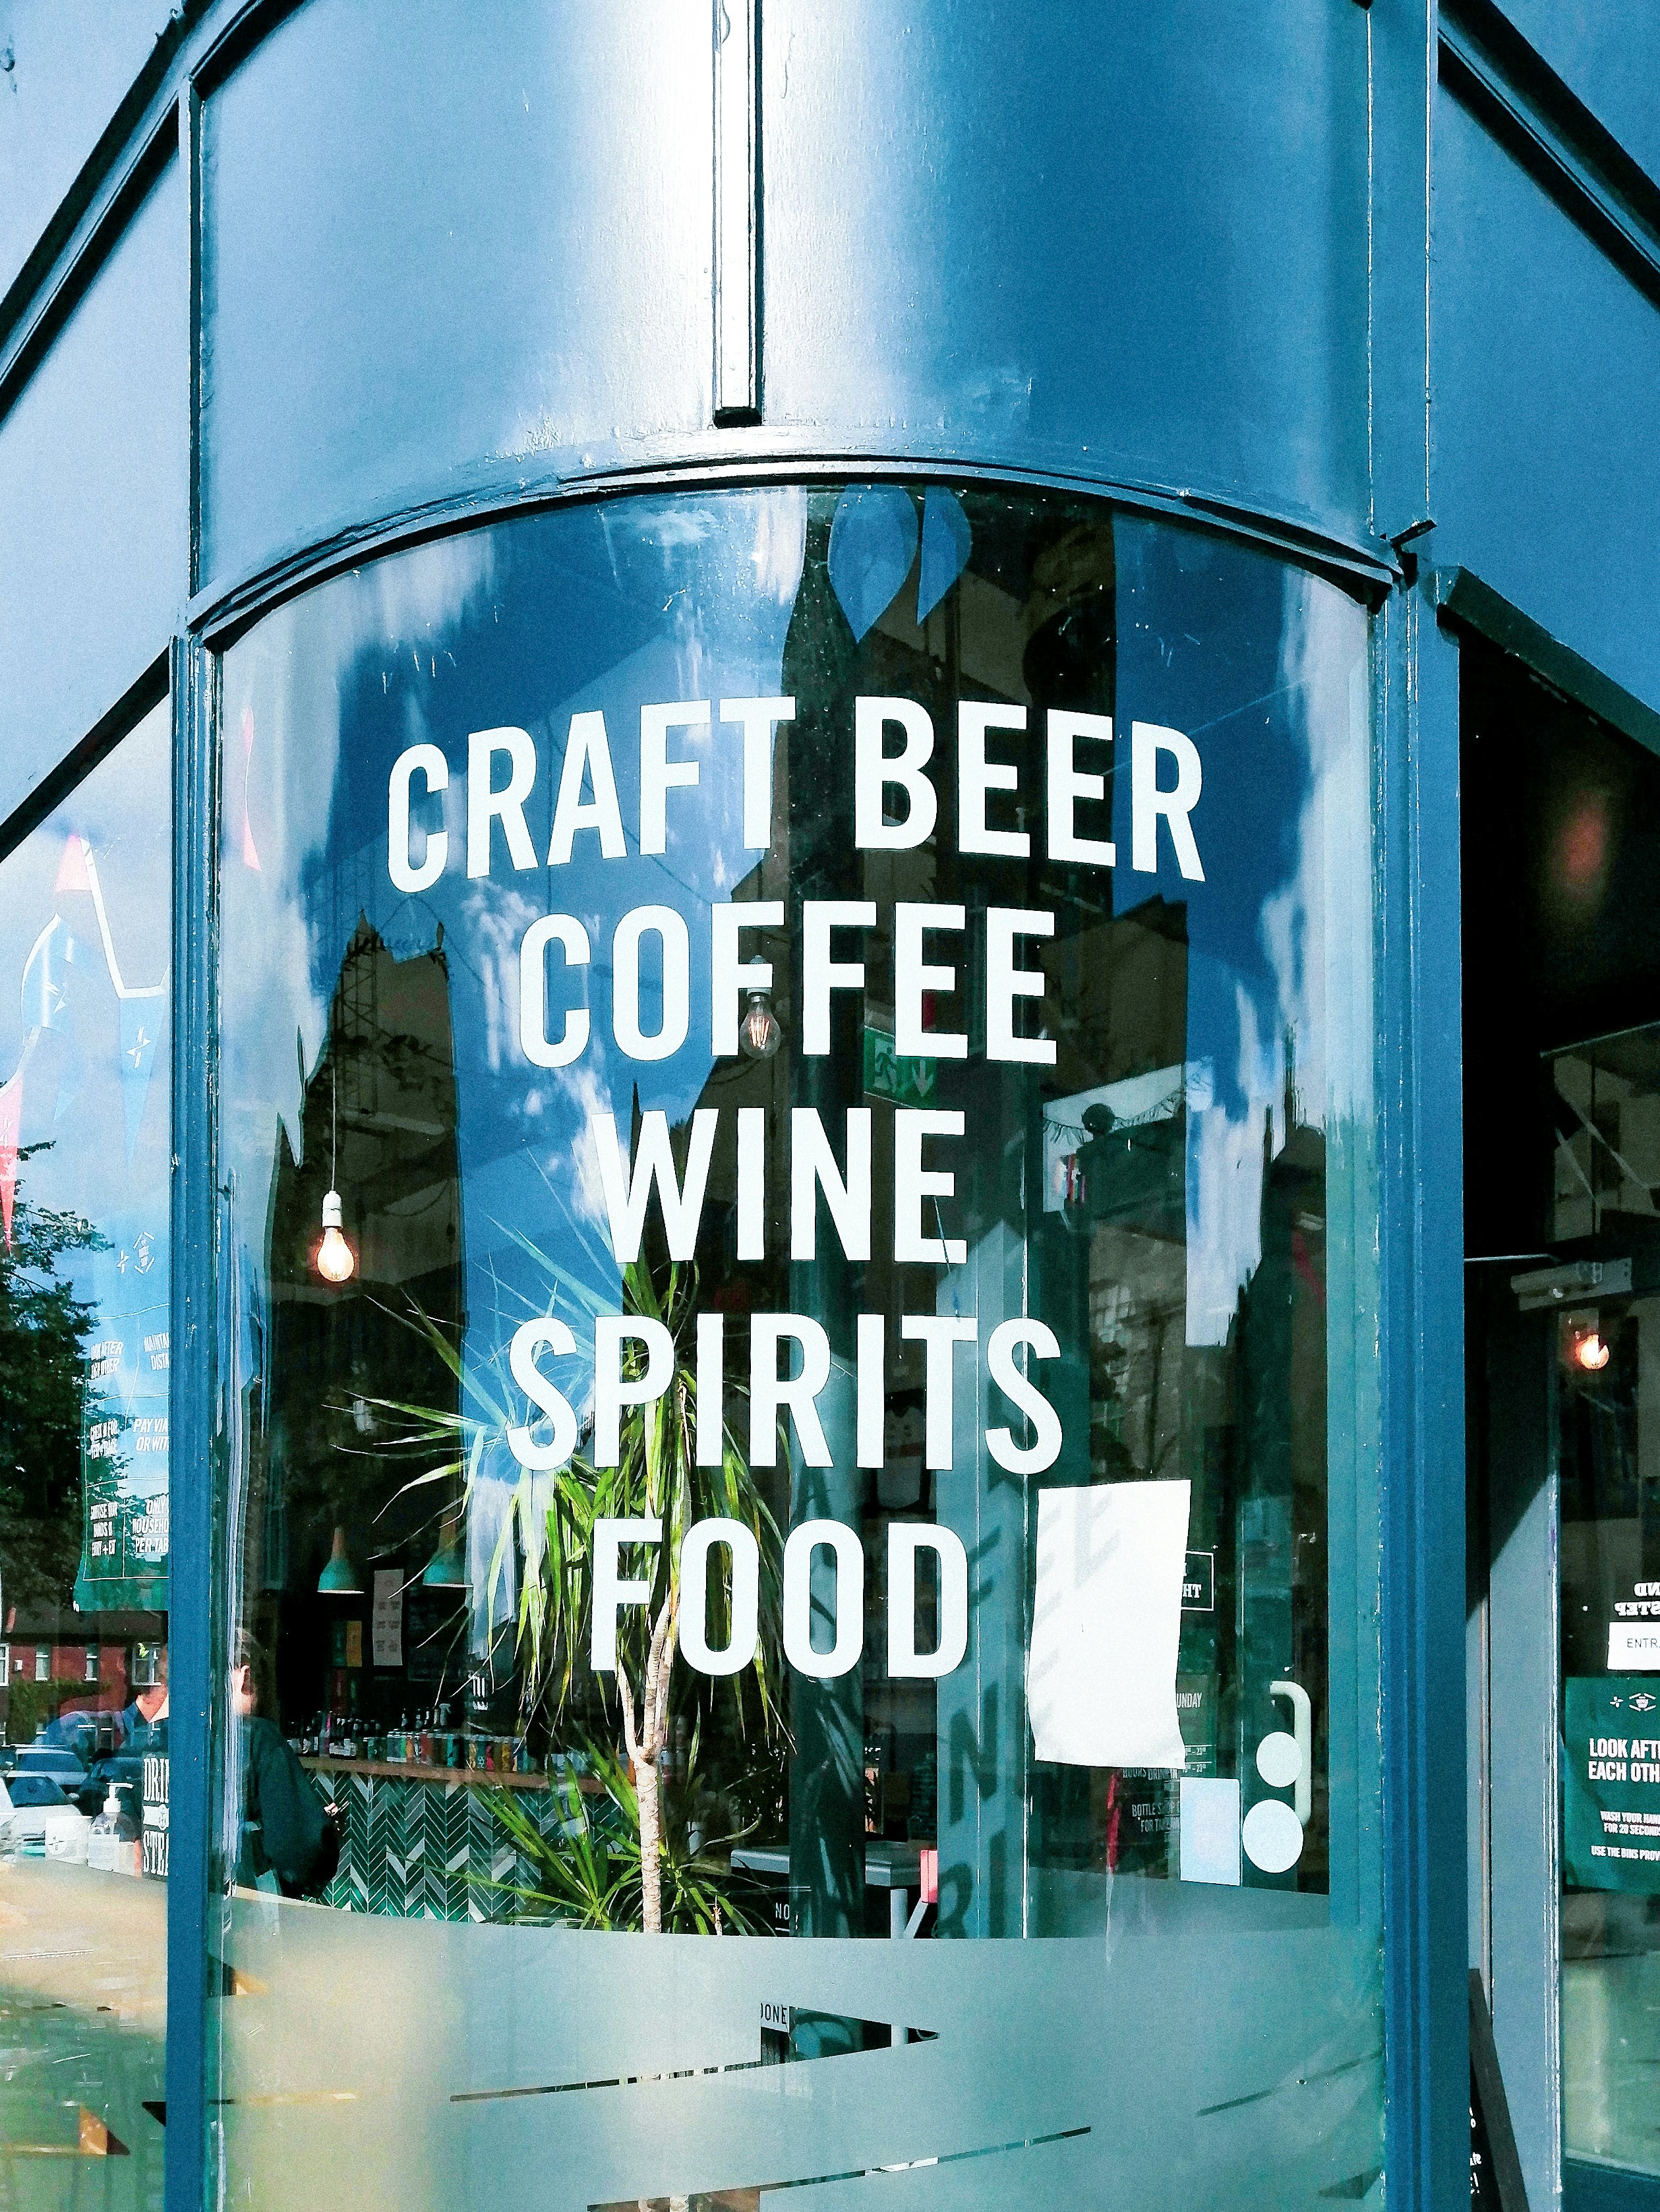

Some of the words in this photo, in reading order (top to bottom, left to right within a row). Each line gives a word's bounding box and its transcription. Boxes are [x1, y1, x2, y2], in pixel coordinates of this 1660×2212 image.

[388, 696, 796, 894] CRAFT
[854, 695, 1206, 883] BEER
[519, 900, 1057, 1068] COFFEE
[591, 1107, 968, 1265] WINE
[506, 1312, 1063, 1474] SPIRITS
[133, 1418, 154, 1433] PAY
[136, 1436, 151, 1451] OR
[152, 1436, 169, 1451] WIT
[134, 1538, 152, 1553] PER
[154, 1538, 169, 1553] TAB
[590, 1517, 969, 1679] FOOD
[1627, 1638, 1660, 1648] ENTR
[1589, 1737, 1628, 1759] LOOK
[1588, 1761, 1628, 1782] EACH
[1630, 1762, 1660, 1784] OTH
[1131, 1804, 1156, 1817] BOTTLE
[1600, 1811, 1621, 1822] WASH
[1621, 1812, 1642, 1824] YOUR
[1603, 1822, 1618, 1834] FOR
[1618, 1824, 1629, 1834] 20
[1591, 1846, 1607, 1857] USE
[1607, 1846, 1620, 1857] THE
[1621, 1848, 1639, 1859] BINS
[775, 1902, 790, 1920] NO
